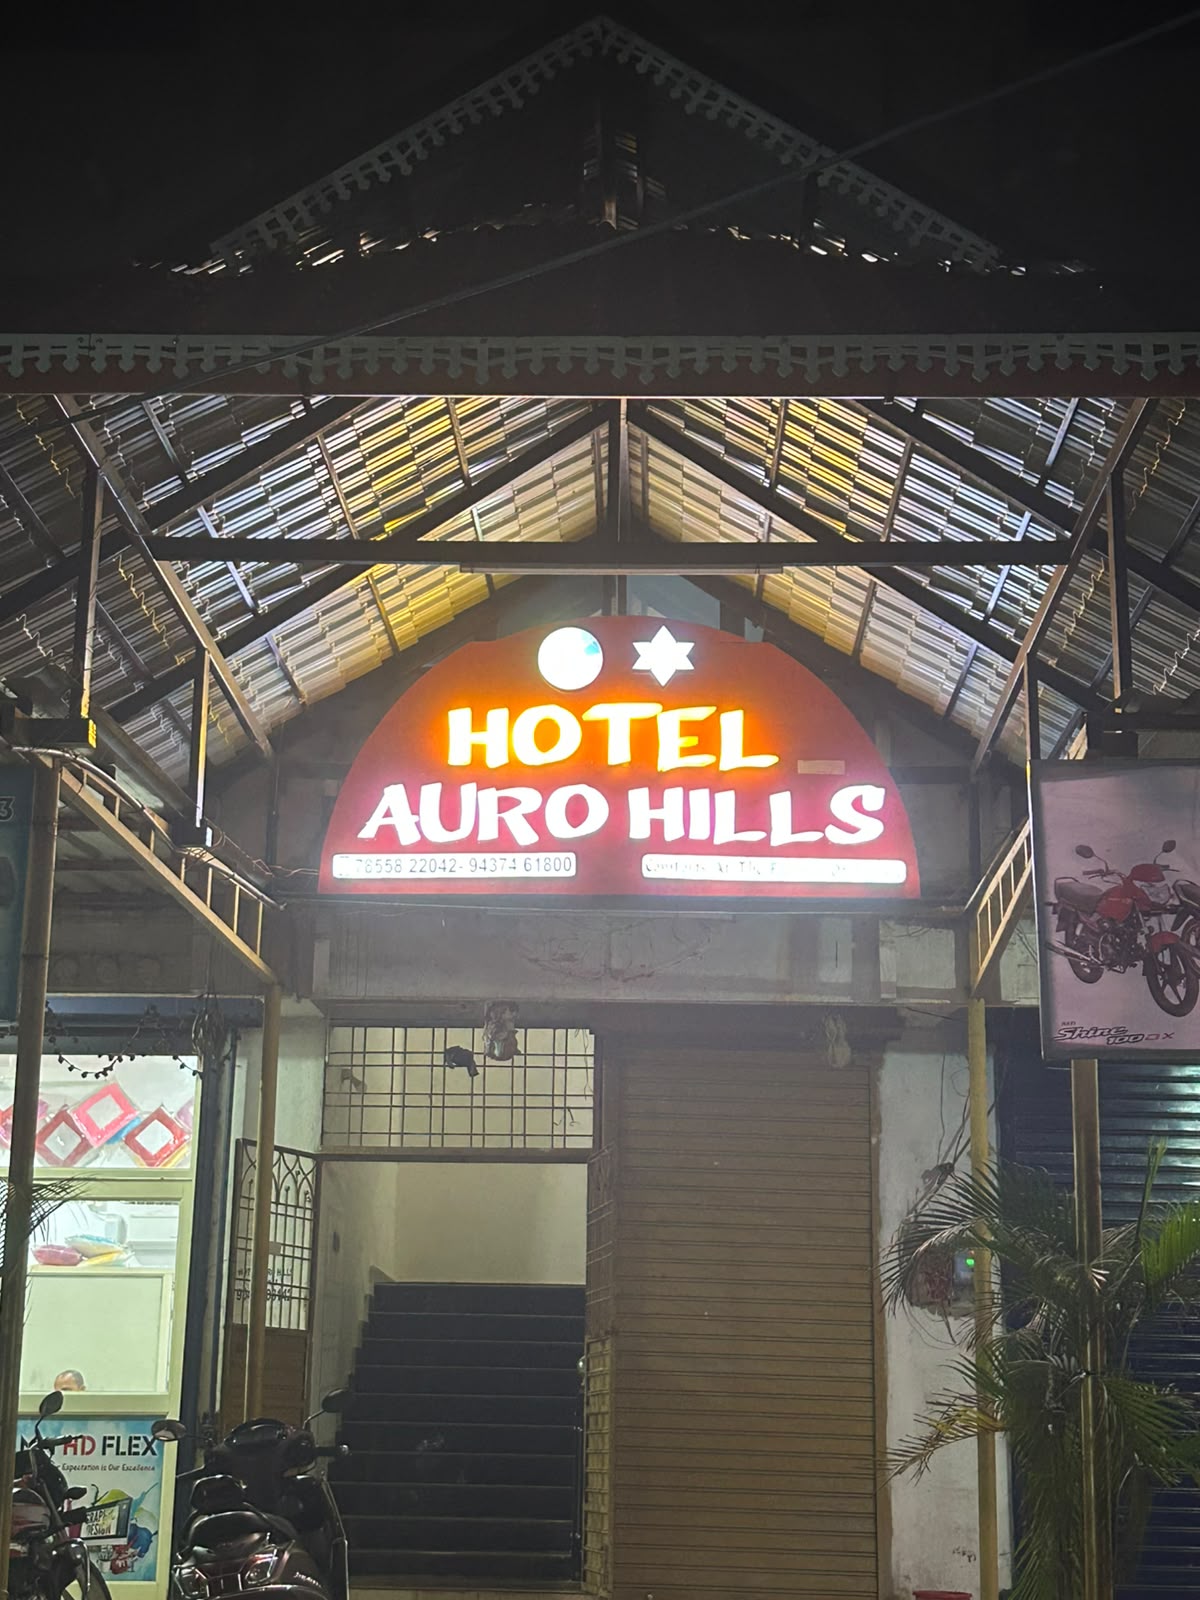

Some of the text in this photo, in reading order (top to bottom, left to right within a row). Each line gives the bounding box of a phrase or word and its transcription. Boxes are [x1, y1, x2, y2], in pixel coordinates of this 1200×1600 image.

[447, 702, 779, 772] HOTEL
[356, 782, 886, 847] AURO HILLS
[469, 857, 517, 873] 94374
[523, 856, 572, 872] 61800
[1054, 1026, 1128, 1040] Shine
[1106, 1034, 1145, 1046] 100
[101, 1435, 157, 1456] FLEX
